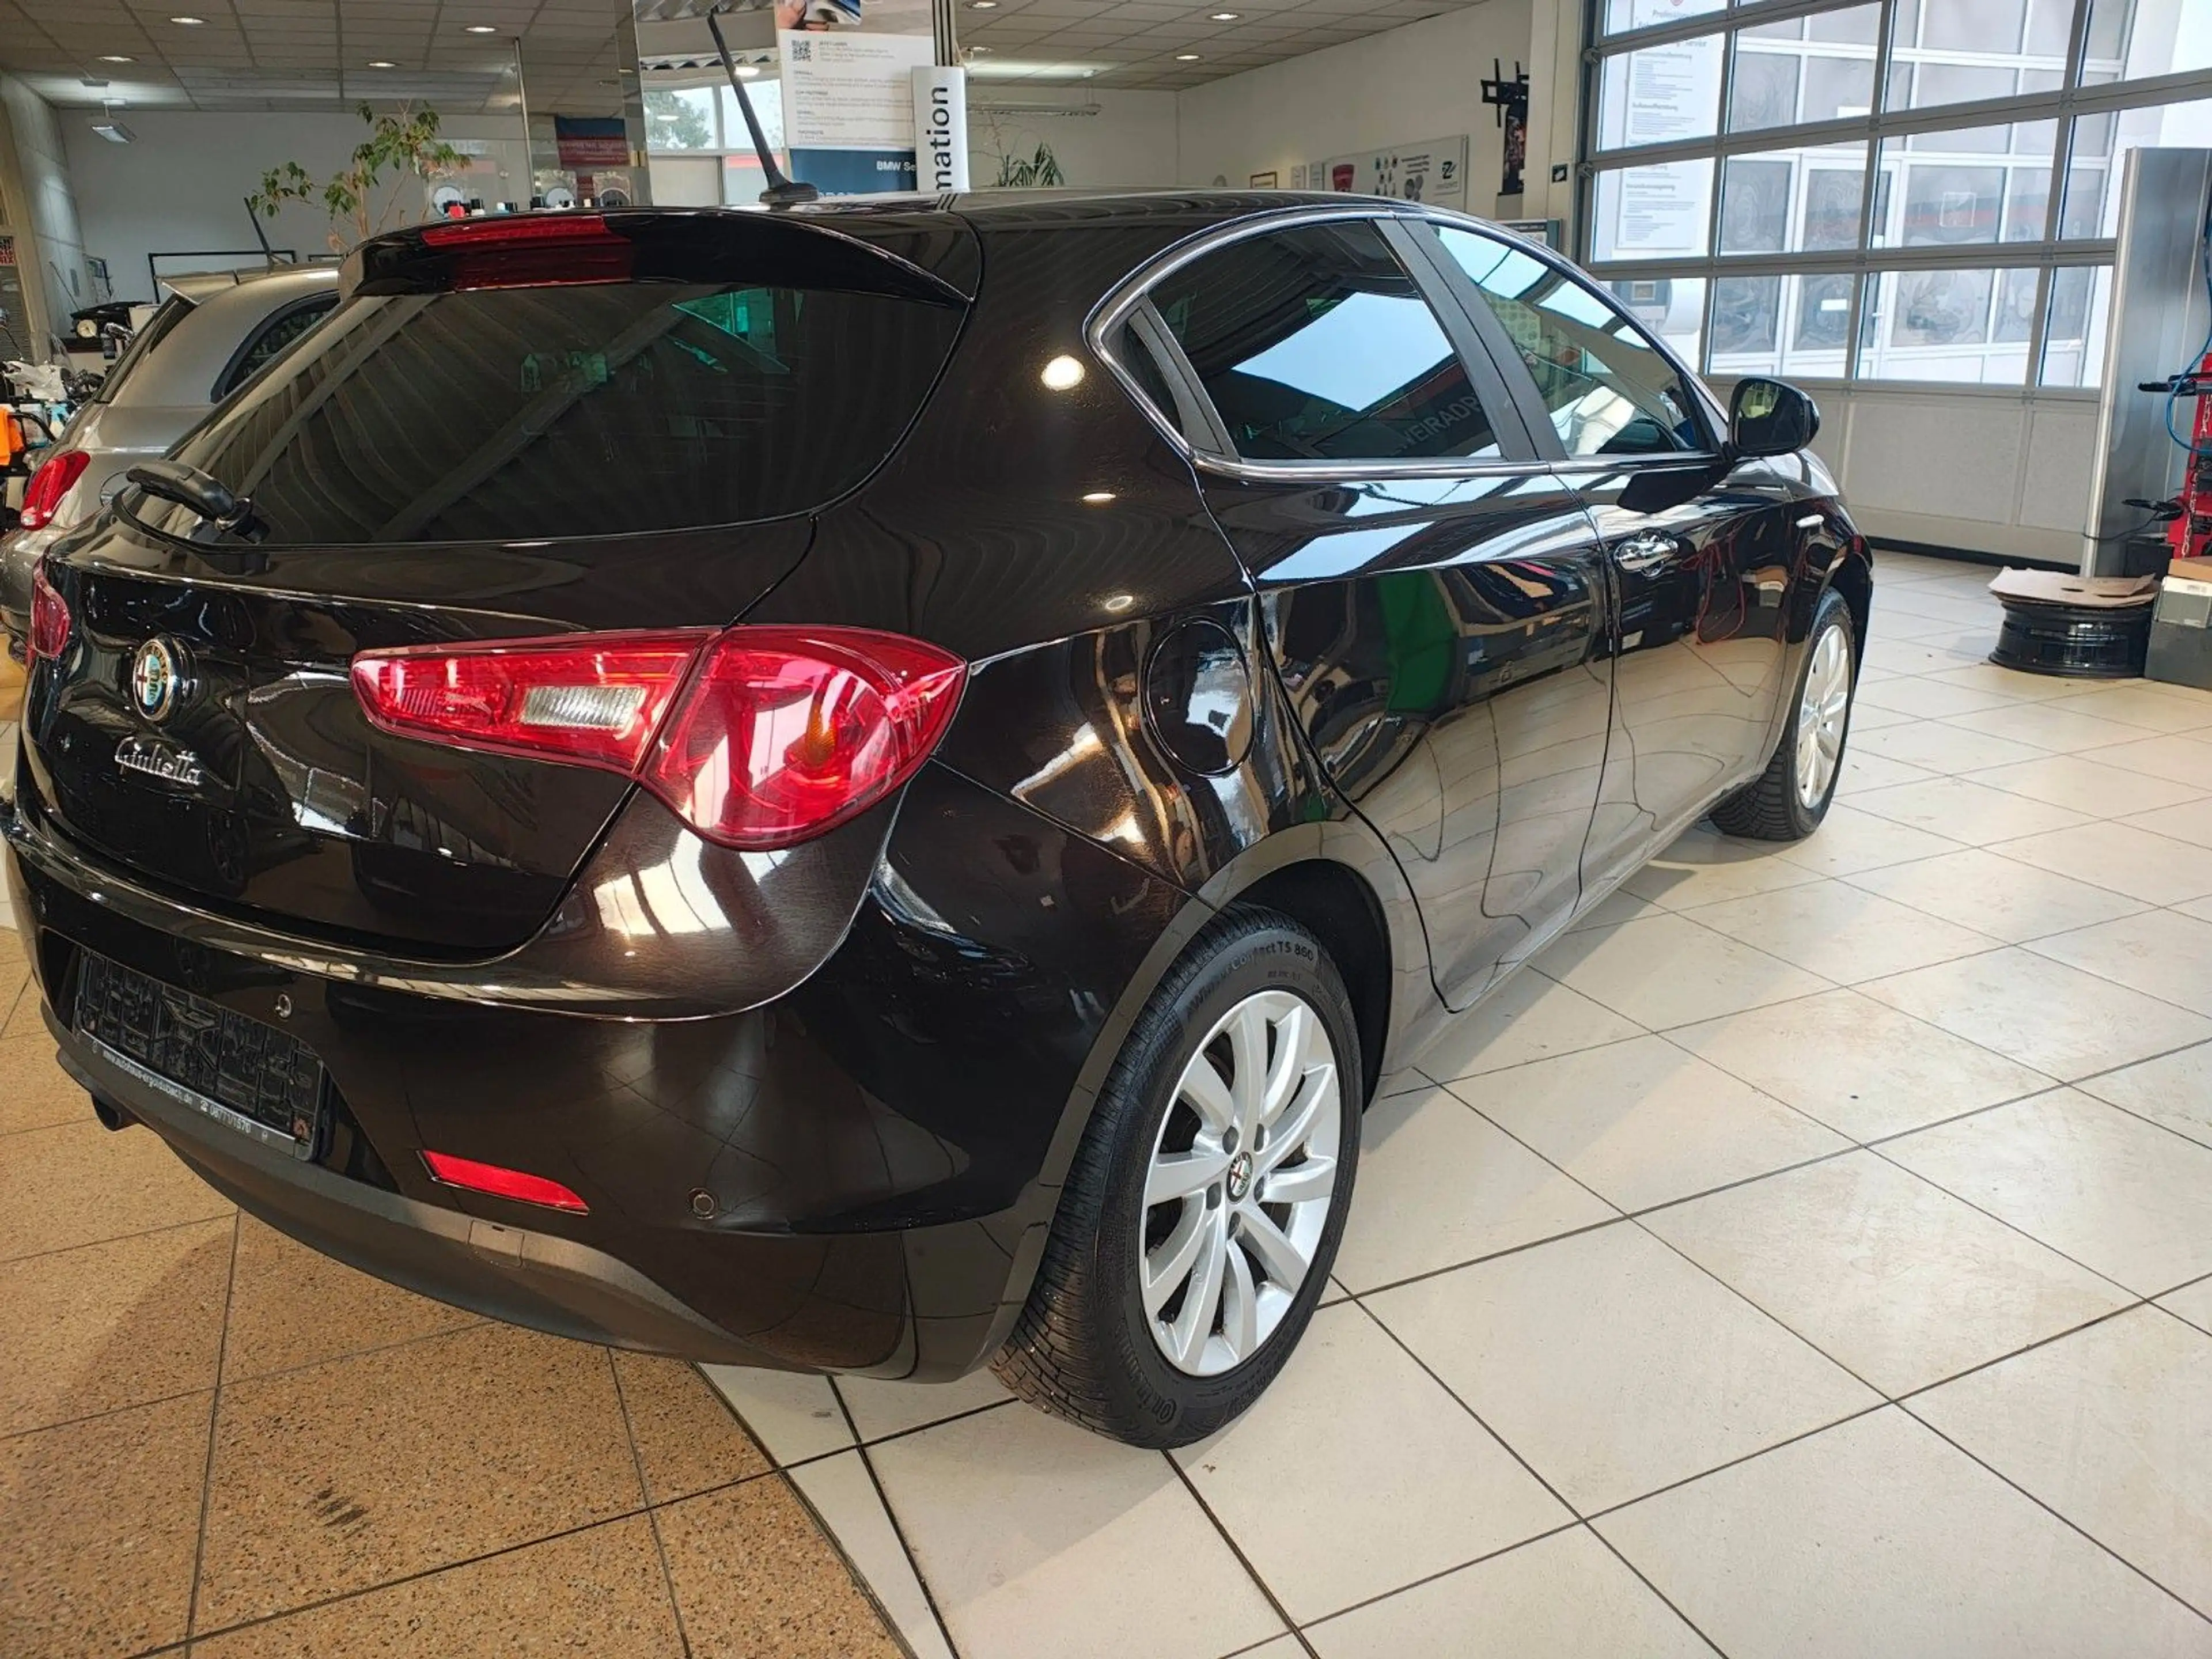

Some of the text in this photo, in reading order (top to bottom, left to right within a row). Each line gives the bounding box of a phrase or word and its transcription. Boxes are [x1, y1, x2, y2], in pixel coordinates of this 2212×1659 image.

[876, 161, 902, 171] BMW
[114, 736, 202, 786] Giulietta
[1277, 941, 1291, 954] TS
[1294, 943, 1314, 962] 860
